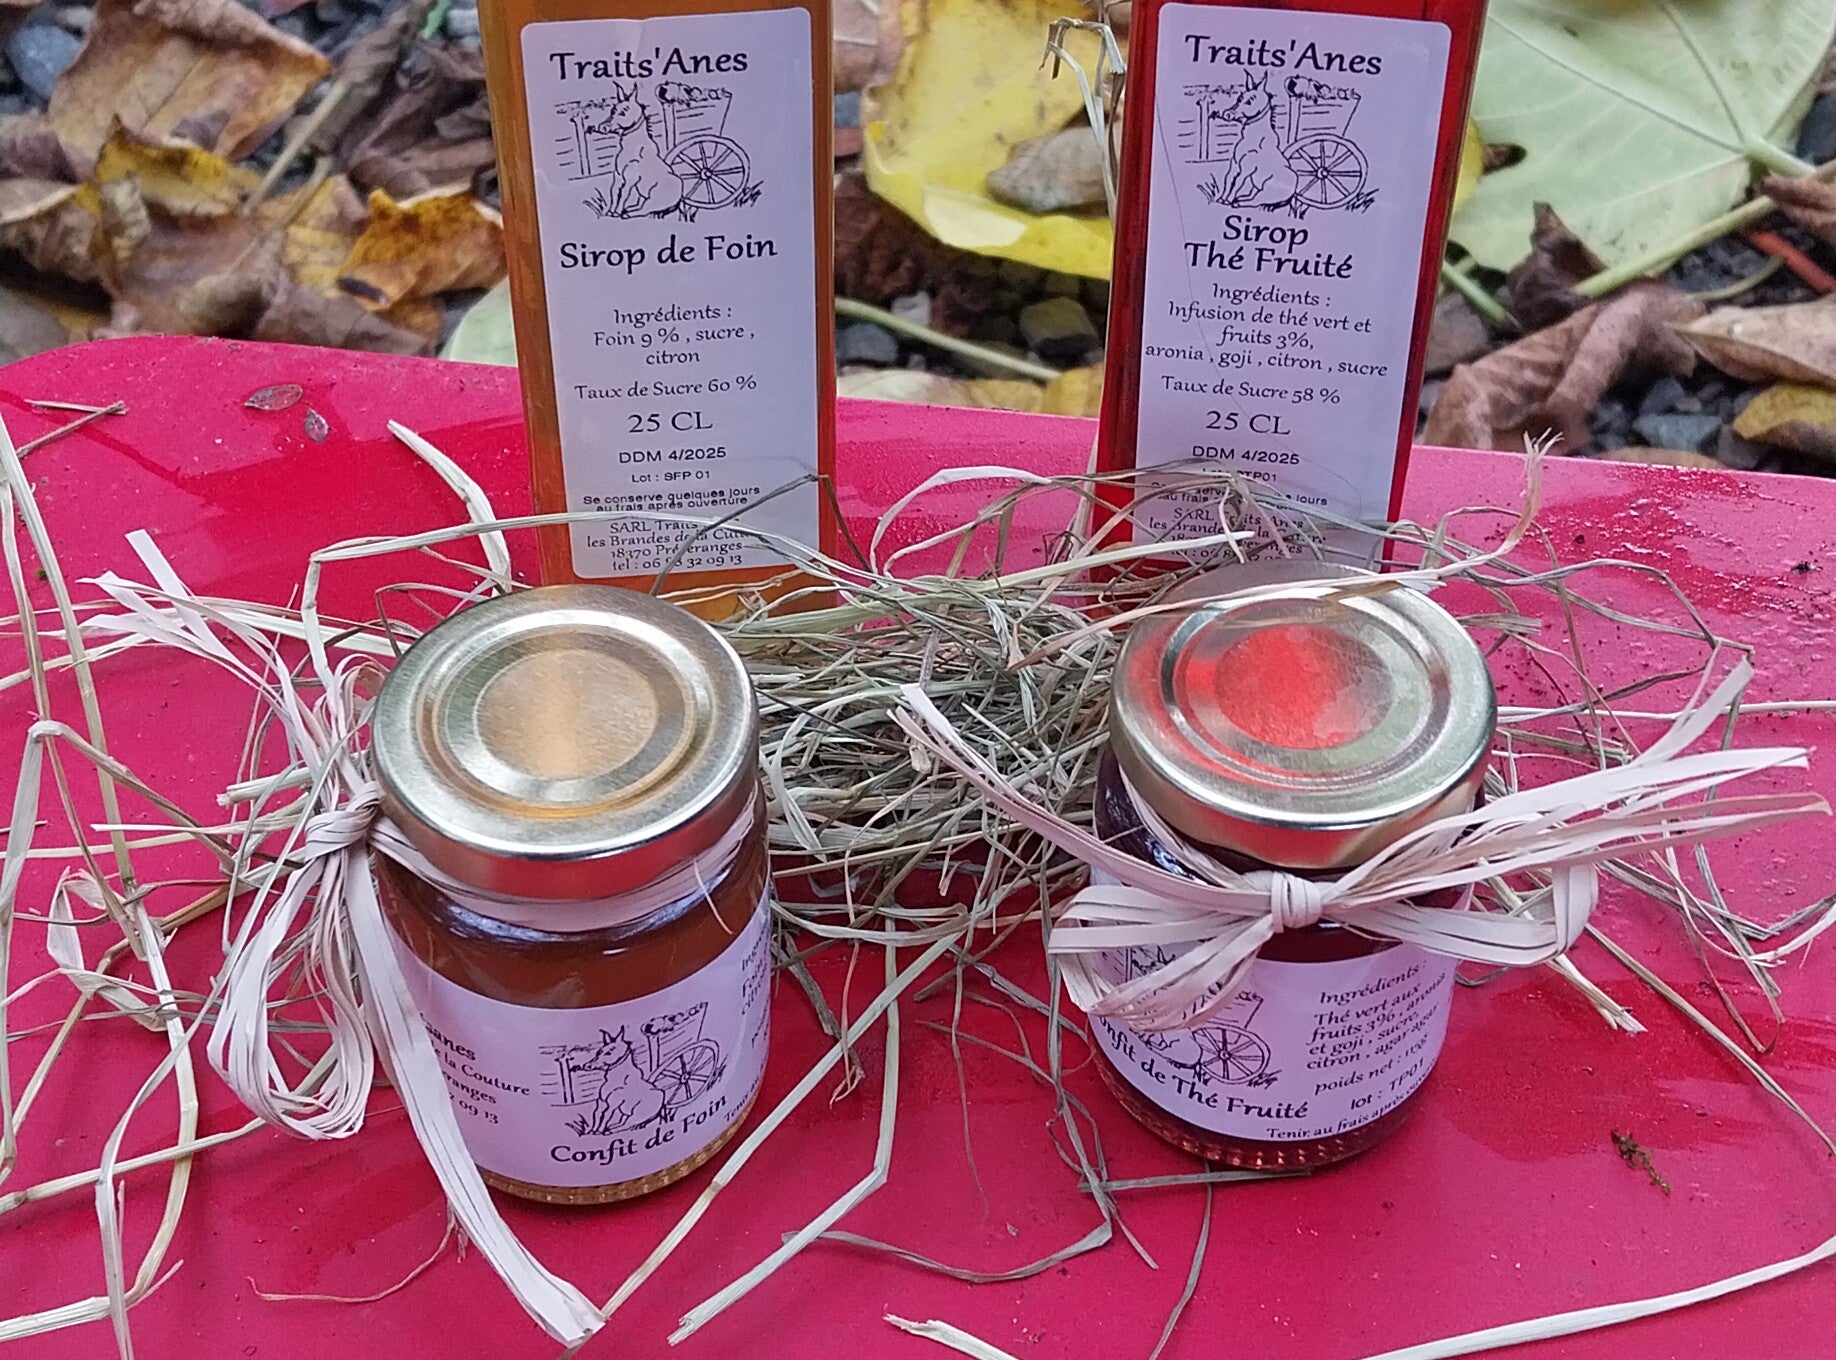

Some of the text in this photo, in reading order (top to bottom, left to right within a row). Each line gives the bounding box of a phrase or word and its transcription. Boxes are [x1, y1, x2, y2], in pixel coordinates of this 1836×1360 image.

[550, 47, 748, 80] Traits'Anes
[1185, 34, 1382, 76] Traits'Anes
[1223, 216, 1309, 254] Sirop
[560, 234, 777, 274] Sirop de Foin
[1184, 240, 1354, 279] Thé Fruité
[1212, 283, 1320, 307] Ingrédients
[613, 304, 721, 329] Ingrédients
[1168, 302, 1372, 333] Infusion de thé vert et
[595, 329, 635, 346] Foin
[641, 333, 652, 348] 9
[658, 327, 679, 344] %
[696, 326, 744, 342] sucre
[1217, 325, 1272, 347] fruits
[645, 351, 700, 365] citron
[1145, 345, 1204, 361] aronia
[1218, 351, 1253, 369] goji
[1267, 353, 1323, 371] citron
[1338, 362, 1388, 378] sucre
[574, 374, 757, 400] Taux de Sucre 60 %
[1161, 375, 1341, 405] Taux de Sucre 58 %
[628, 411, 714, 433] 25 CL
[1205, 410, 1291, 436] 25 CL
[619, 446, 727, 464] DDM 4/2025
[1192, 445, 1300, 465] DDM 4/2025
[631, 472, 652, 483] Lot
[664, 471, 692, 482] SFP
[695, 469, 711, 480] 01
[583, 495, 601, 505] Se
[604, 492, 663, 505] conserve
[667, 490, 725, 505] quelques
[648, 500, 683, 512] après
[687, 496, 748, 509] ouverture
[610, 521, 651, 534] SARL
[1149, 516, 1167, 530] les
[1257, 526, 1269, 538] la
[587, 536, 606, 548] les
[611, 533, 671, 547] Brandes
[611, 548, 651, 559] 18370
[642, 557, 661, 569] 06
[687, 557, 702, 569] 32
[706, 556, 725, 567] 09
[729, 554, 742, 565] 13
[1319, 965, 1419, 1006] Ingrédients
[1314, 983, 1422, 1026] Thé vert aux
[1306, 1024, 1362, 1046] fruits
[1309, 1043, 1329, 1056] et
[1330, 1035, 1364, 1057] goji
[445, 1052, 456, 1069] la
[461, 1063, 531, 1096] Couture
[1306, 1053, 1361, 1070] citron
[1140, 1058, 1167, 1084] de
[1171, 1075, 1218, 1109] Thé
[1226, 1096, 1309, 1119] Fruité
[1315, 1071, 1364, 1096] poids
[1368, 1058, 1394, 1078] net
[1350, 1094, 1373, 1110] lot
[1388, 1057, 1424, 1092] TP01
[550, 1095, 728, 1166] Confit de Foin
[1314, 1126, 1333, 1139] au
[1336, 1114, 1369, 1134] frais
